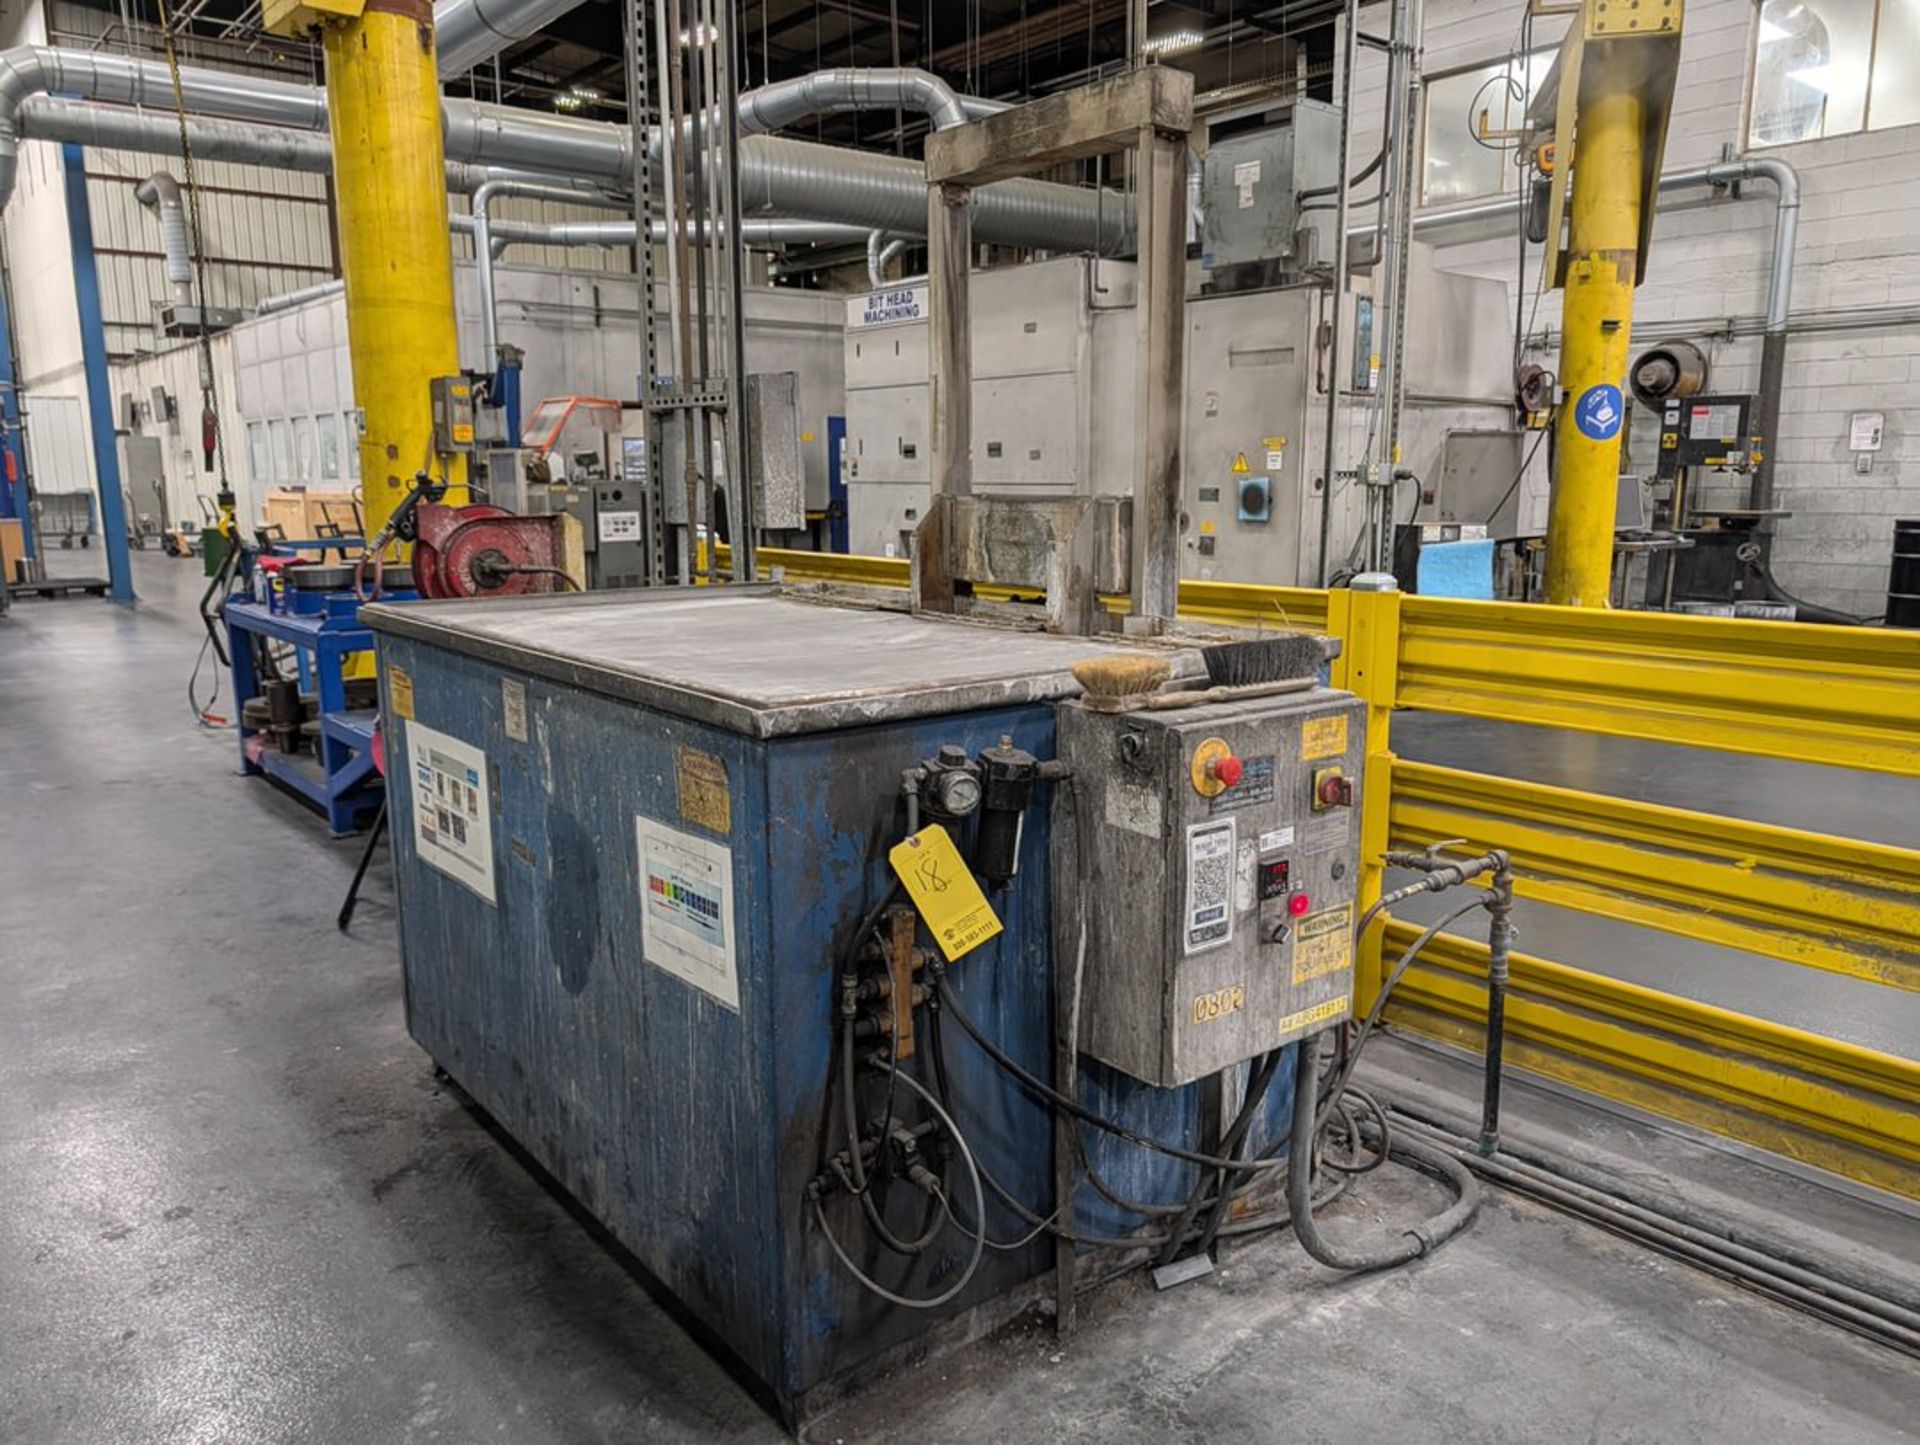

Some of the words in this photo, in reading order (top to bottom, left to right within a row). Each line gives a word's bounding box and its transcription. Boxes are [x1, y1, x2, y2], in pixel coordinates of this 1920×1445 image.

[868, 296, 883, 309] BIT
[887, 291, 913, 306] HEAD
[864, 303, 920, 323] MACHINING
[914, 857, 952, 892] 18
